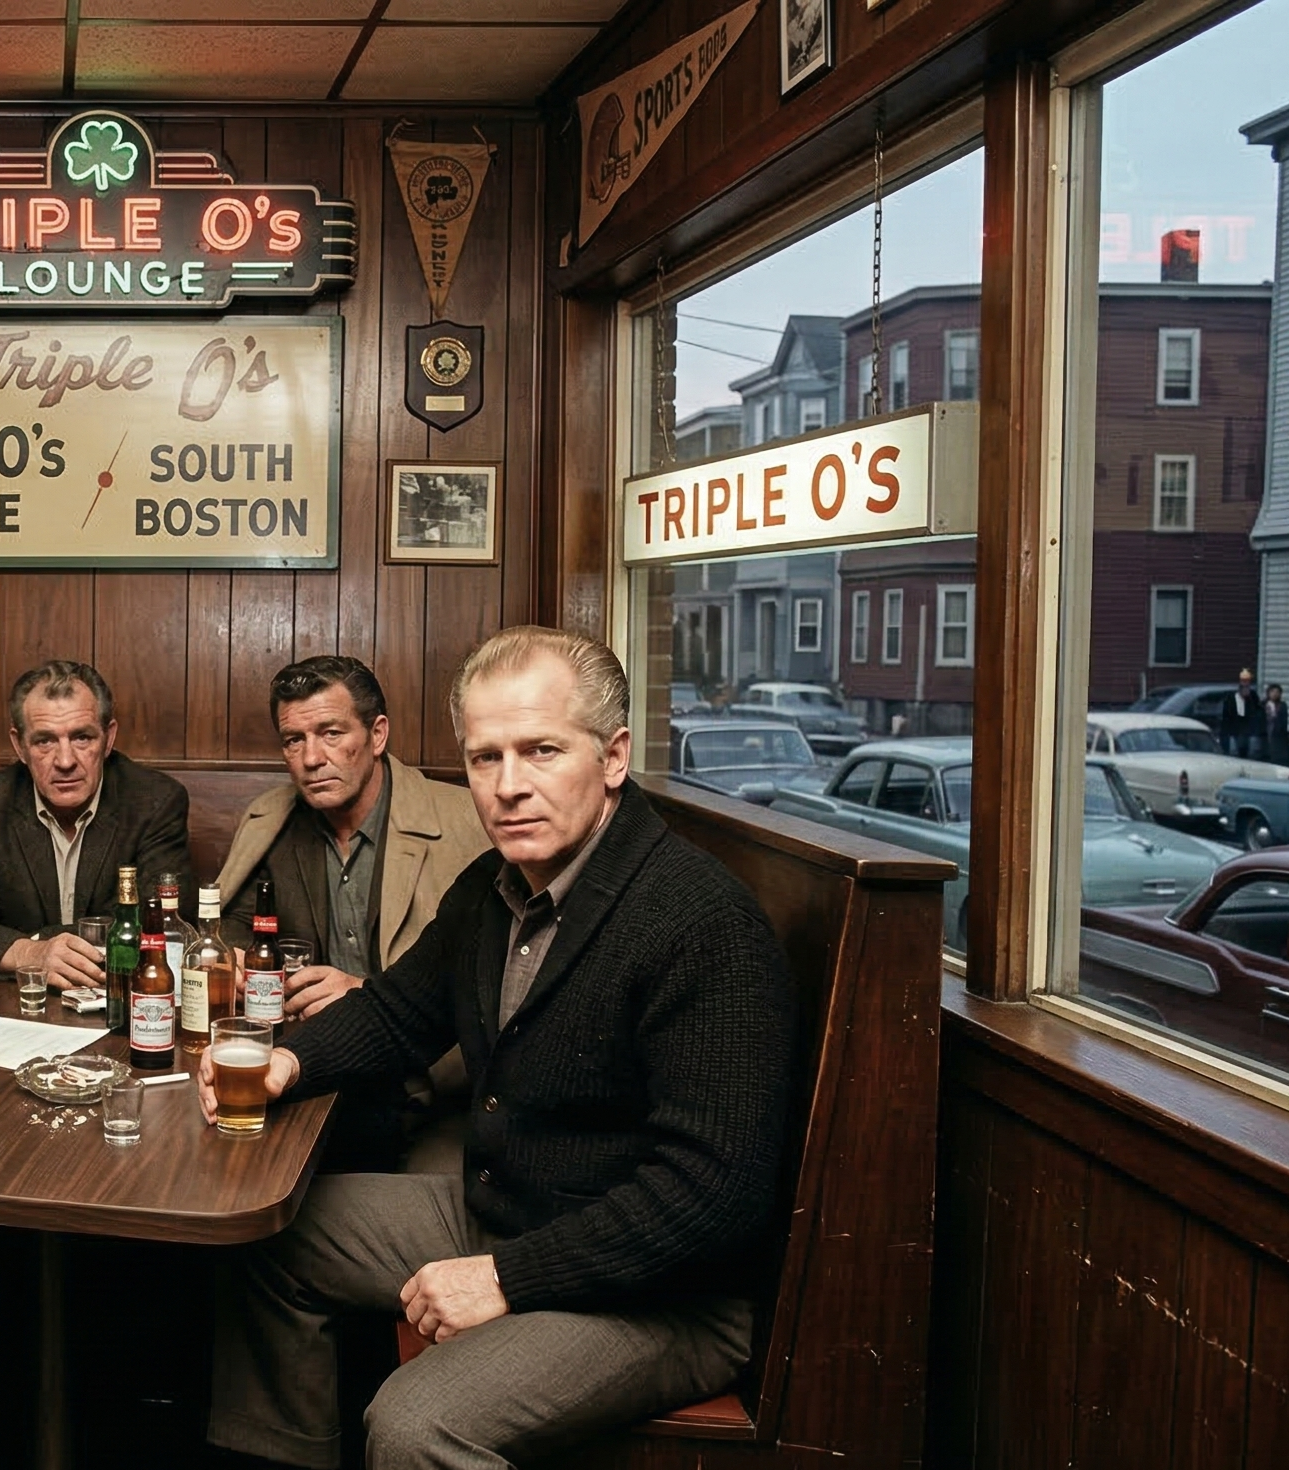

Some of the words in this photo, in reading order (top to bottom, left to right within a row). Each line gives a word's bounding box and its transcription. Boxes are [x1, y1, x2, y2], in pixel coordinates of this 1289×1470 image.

[633, 52, 693, 159] SPORTS
[201, 195, 303, 251] O's
[178, 334, 279, 421] O's
[149, 443, 293, 482] SOUTH
[135, 498, 308, 537] BOSTON
[638, 464, 788, 544] TRIPLE
